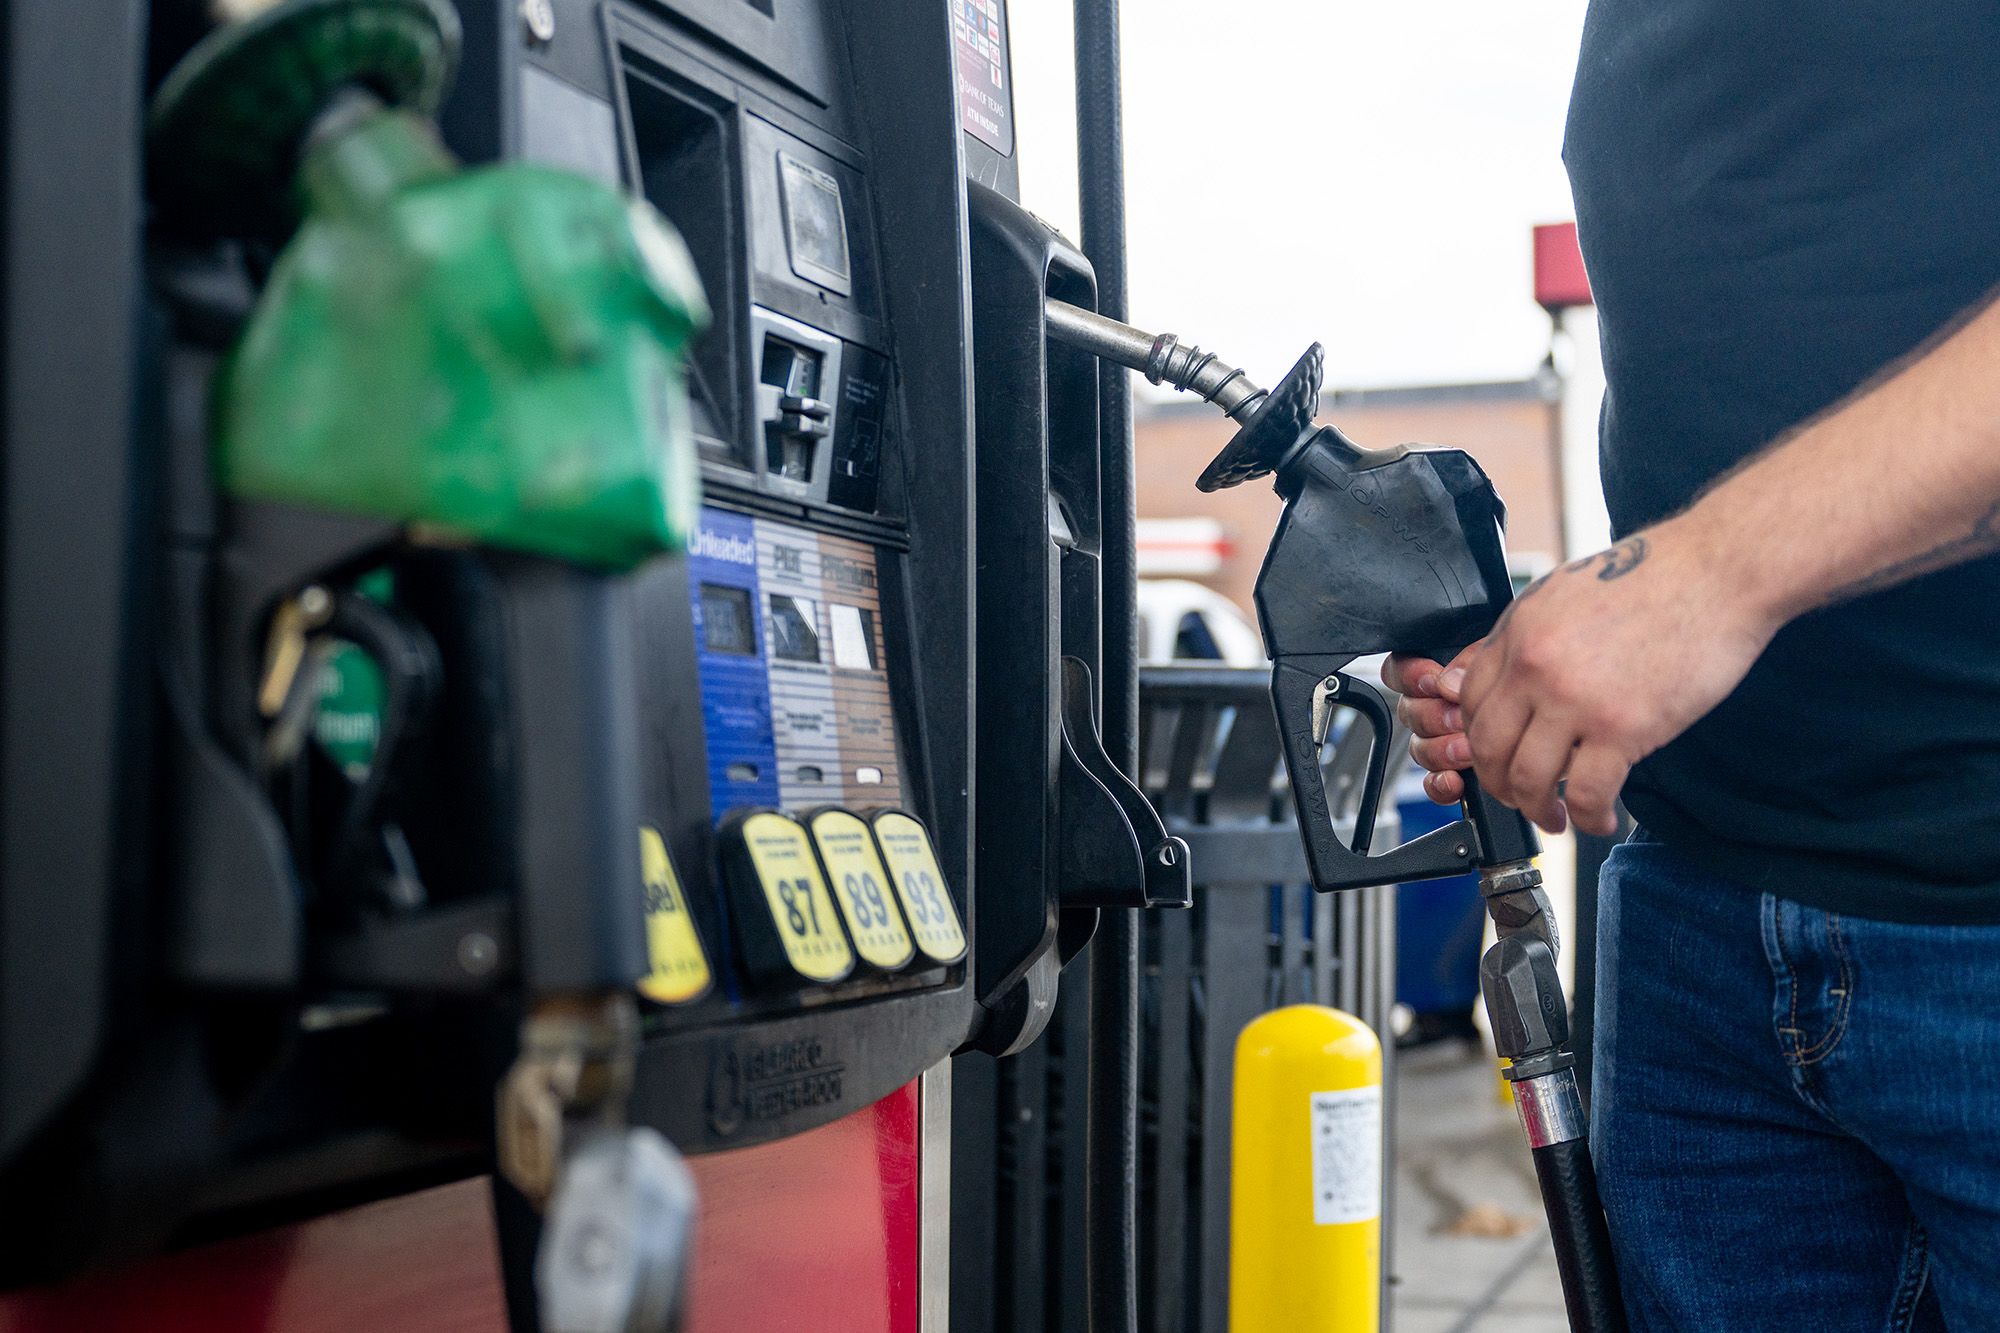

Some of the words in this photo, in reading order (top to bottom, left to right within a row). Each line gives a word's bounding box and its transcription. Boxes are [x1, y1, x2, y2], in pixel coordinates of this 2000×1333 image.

[965, 80, 980, 100] BANK
[988, 97, 1004, 118] TEXAS
[967, 105, 980, 124] ATM
[980, 114, 999, 137] INSIDE
[778, 879, 820, 936] 87
[845, 872, 889, 928] 89
[904, 872, 945, 924] 93
